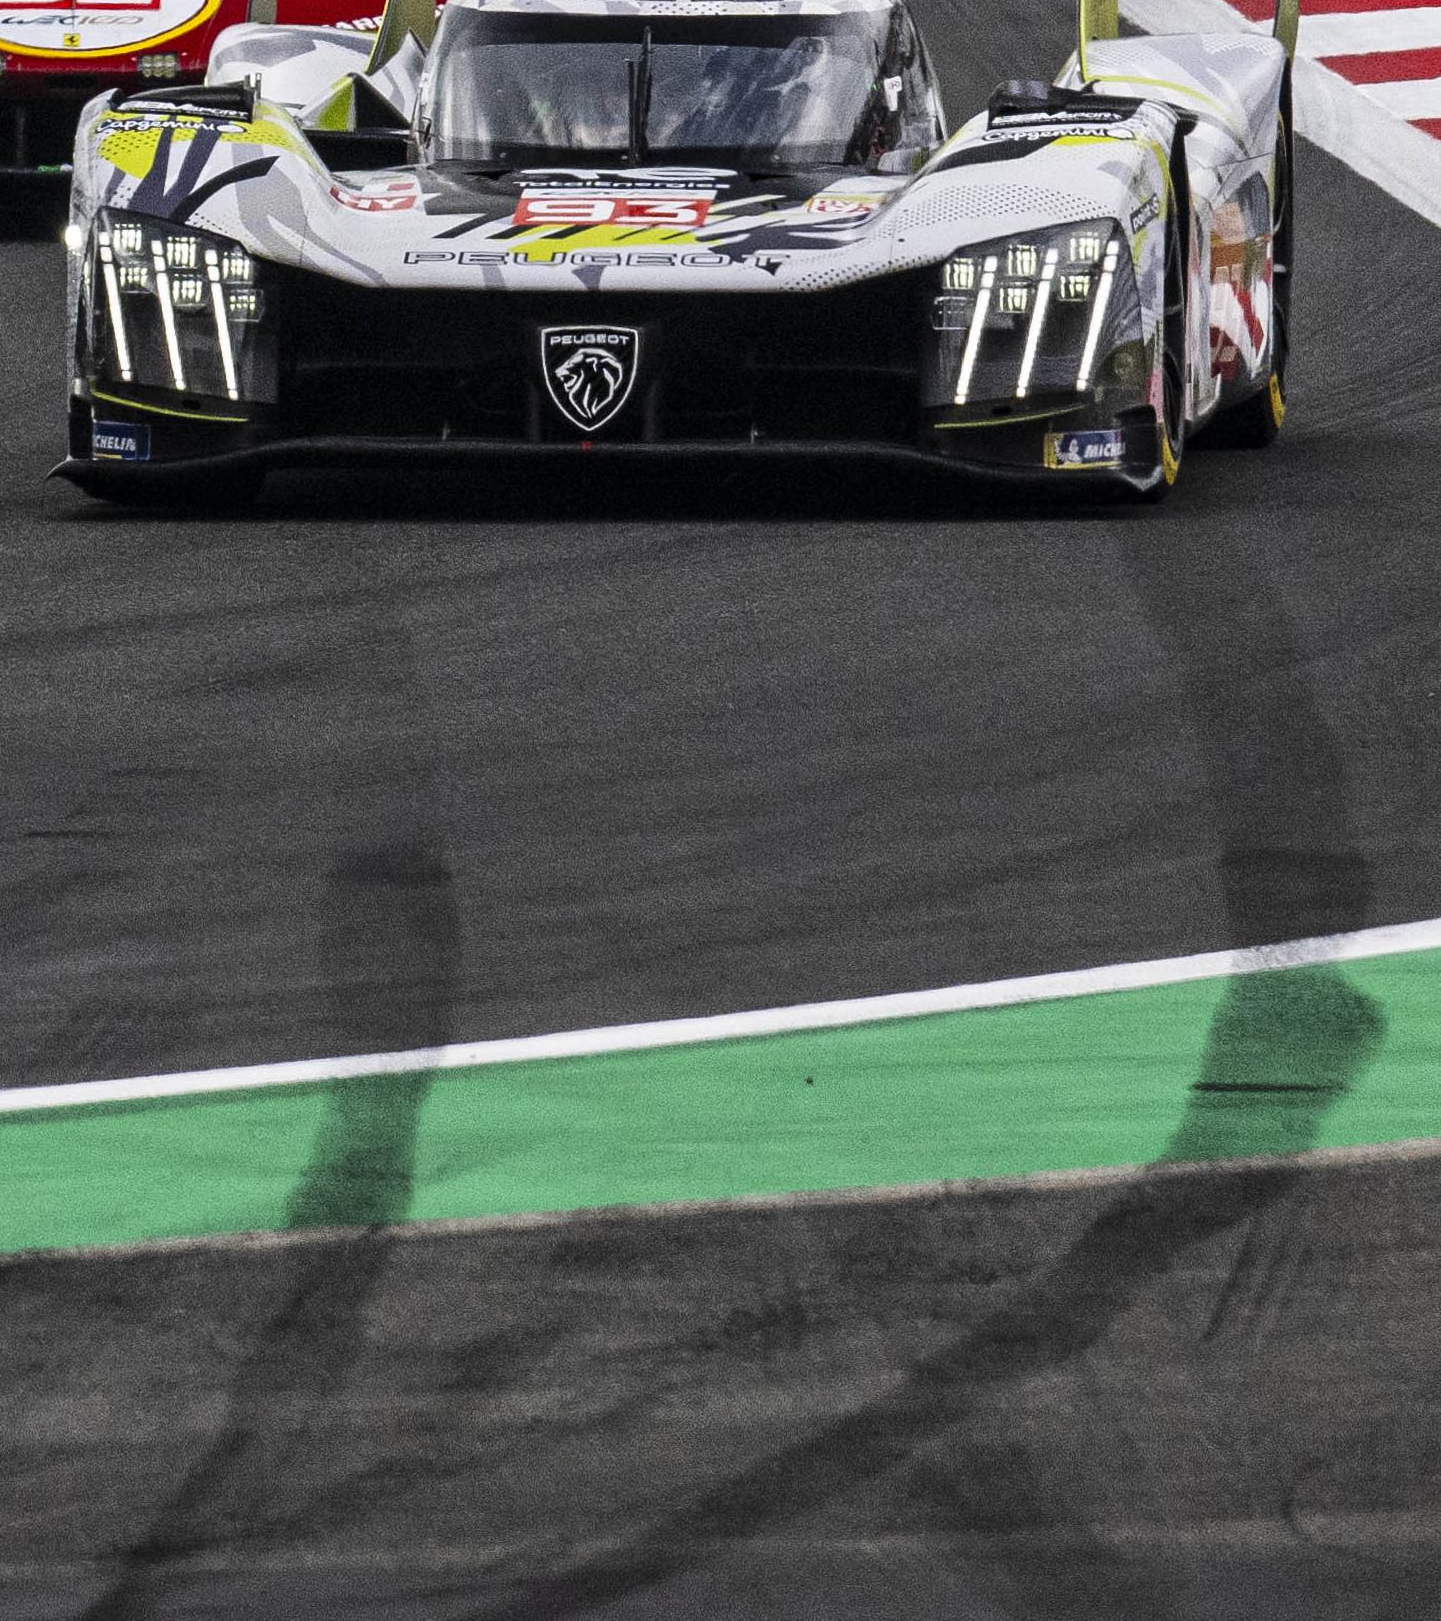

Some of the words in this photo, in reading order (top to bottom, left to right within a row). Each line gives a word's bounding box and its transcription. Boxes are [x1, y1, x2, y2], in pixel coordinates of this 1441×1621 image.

[981, 127, 1106, 142] Capgemini
[514, 180, 731, 189] TotalEnergies
[526, 199, 698, 223] 93
[404, 249, 791, 267] PEUGEOT
[550, 334, 630, 346] PEUGEOT
